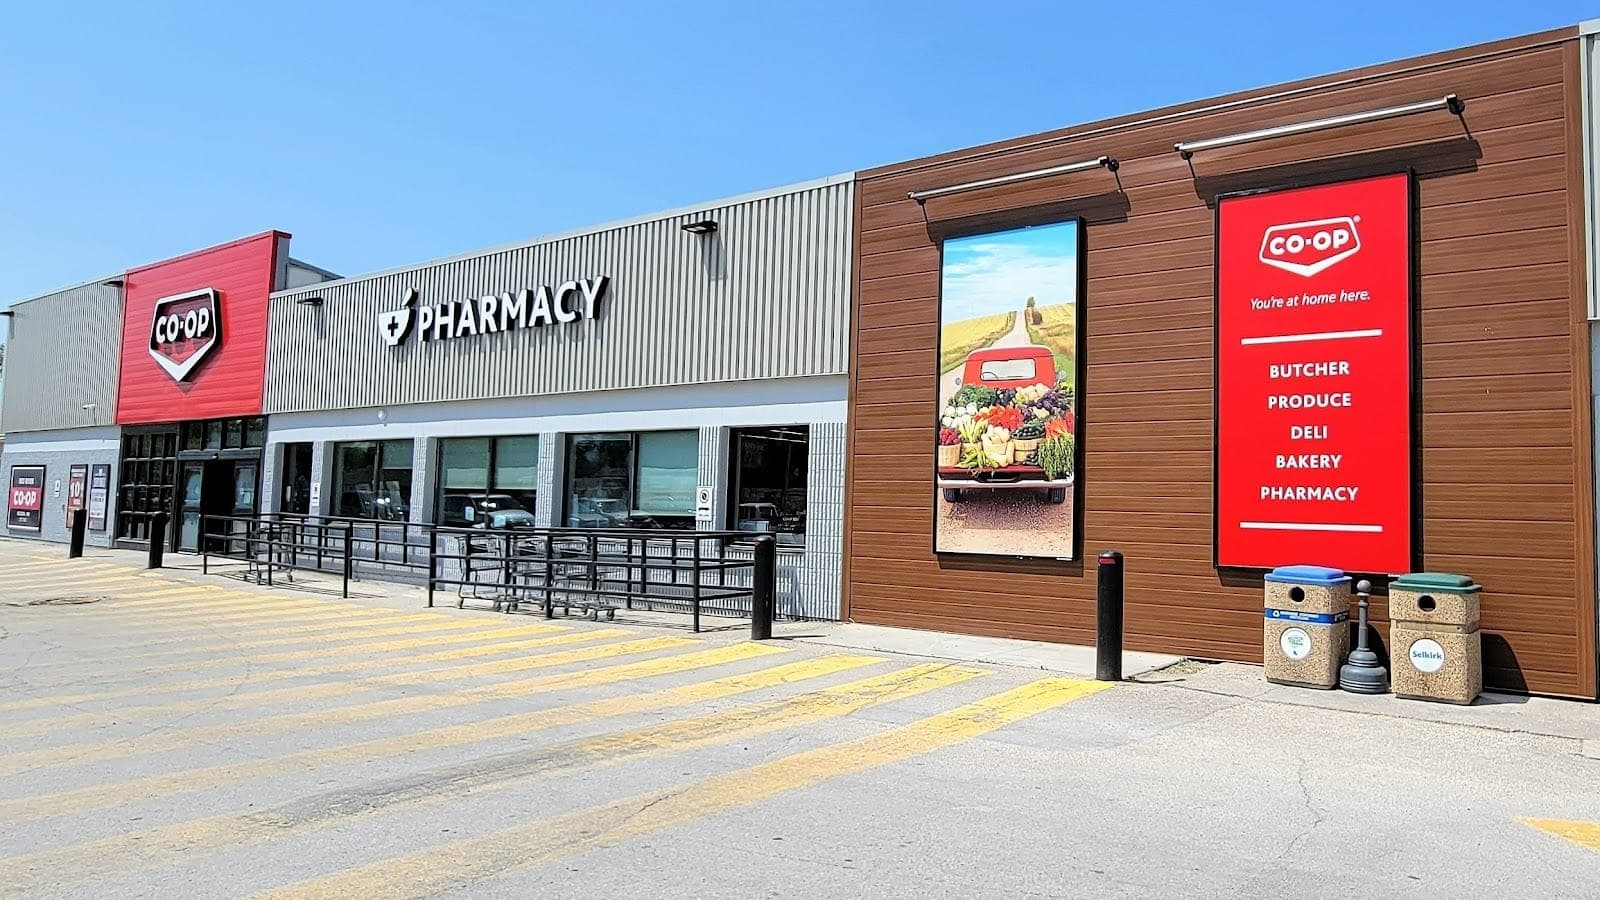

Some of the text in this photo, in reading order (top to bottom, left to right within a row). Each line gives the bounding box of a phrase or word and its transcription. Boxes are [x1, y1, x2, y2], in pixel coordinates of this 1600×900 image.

[1269, 229, 1349, 255] CO-OP
[1250, 289, 1371, 311] You're at home here.
[417, 276, 610, 341] PHARMACY
[155, 307, 210, 344] CO-OP
[1270, 361, 1350, 378] BUTCHER
[1268, 393, 1352, 409] PRODUCE
[1291, 425, 1328, 440] DELI
[1275, 455, 1342, 469] BAKERY
[1260, 486, 1359, 501] PHARMACY
[1412, 650, 1442, 659] Selkirk
